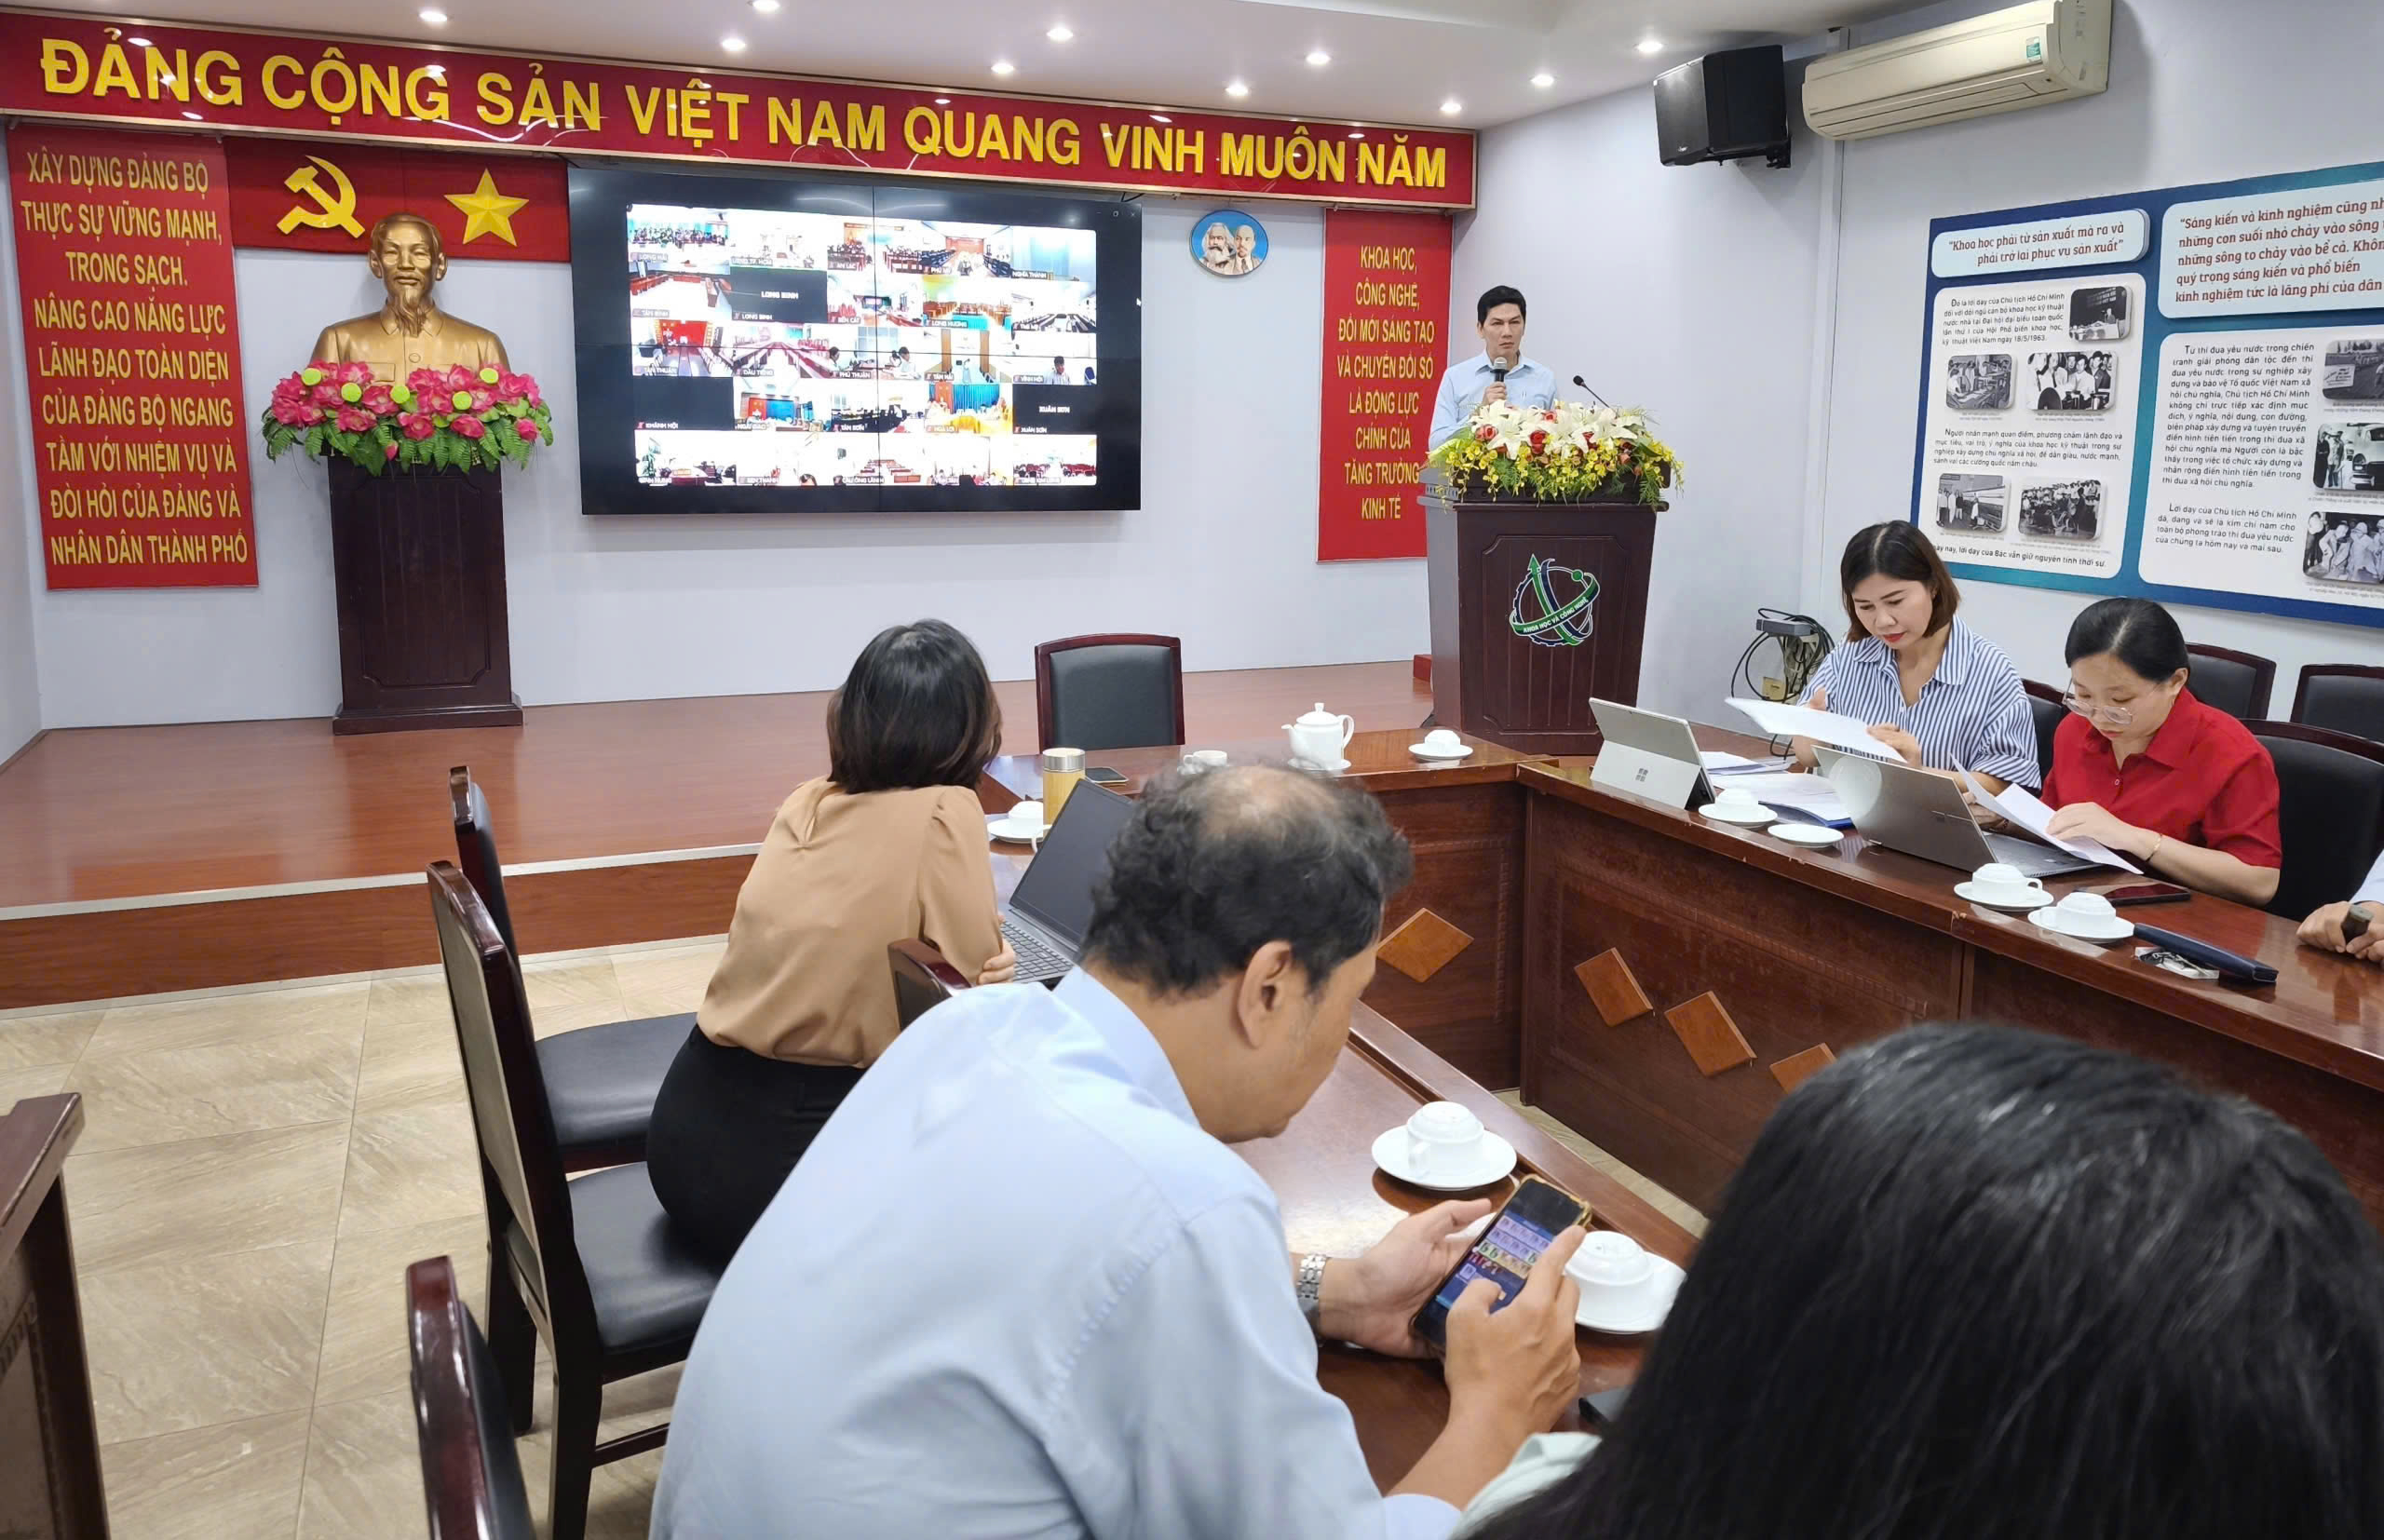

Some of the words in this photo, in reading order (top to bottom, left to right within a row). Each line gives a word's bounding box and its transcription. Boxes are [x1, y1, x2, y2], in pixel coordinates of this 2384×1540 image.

[40, 27, 243, 105] ĐẢNG
[262, 47, 450, 128] CỘNG
[477, 62, 601, 131] SẢN
[625, 78, 750, 148] VIỆT
[767, 97, 886, 152] NAM
[903, 106, 1079, 166] QUANG
[1100, 123, 1204, 173] VINH
[1220, 126, 1346, 182] MUÔN
[1359, 133, 1445, 188] NĂM
[27, 145, 63, 184] XÂY
[69, 155, 124, 194] DỰNG
[127, 152, 179, 192] ĐẢNG
[183, 159, 209, 200] BỘ
[20, 200, 74, 240] THỰC
[78, 203, 104, 242] SỰ
[108, 200, 162, 238] VỮNG
[166, 209, 222, 246] MẠNH,
[2215, 210, 2238, 226] kiến
[2241, 210, 2255, 223] và
[2257, 208, 2283, 222] kinh
[2287, 203, 2333, 221] nghiệm
[2336, 201, 2367, 214] cũng
[2179, 236, 2214, 248] những
[2216, 235, 2236, 244] con
[2239, 227, 2263, 243] suối
[2266, 226, 2288, 240] nhỏ
[2290, 223, 2321, 239] chảy
[2323, 222, 2346, 235] vào
[2349, 219, 2379, 234] sông
[65, 251, 129, 284] TRONG
[1361, 245, 1390, 269] KHOA
[1392, 247, 1417, 275] HỌC,
[2178, 253, 2213, 266] những
[2215, 250, 2242, 264] sông
[2244, 251, 2256, 261] to
[2258, 246, 2287, 261] chảy
[2290, 245, 2312, 257] vào
[2315, 239, 2330, 255] bể
[2332, 240, 2350, 253] cả.
[2176, 272, 2197, 287] quý
[2200, 272, 2229, 284] trọng
[2232, 268, 2260, 282] sáng
[2262, 263, 2287, 278] kiến
[2291, 263, 2305, 276] và
[2308, 259, 2332, 277] phổ
[2334, 257, 2361, 274] biến
[1356, 277, 1387, 306] CÔNG
[1388, 282, 1419, 312] NGHỆ,
[2175, 290, 2200, 303] kinh
[2201, 288, 2243, 304] nghiệm
[2246, 284, 2265, 298] tức
[2268, 285, 2278, 297] là
[2281, 284, 2308, 298] lãng
[2310, 282, 2329, 297] phí
[2332, 280, 2355, 293] của
[2358, 278, 2382, 291] dân
[34, 291, 87, 330] NÂNG
[91, 300, 129, 331] CAO
[134, 296, 185, 333] NĂNG
[189, 304, 226, 341] LỰC
[1338, 313, 1357, 342] ĐỔI
[1359, 314, 1379, 343] MỚI
[1382, 315, 1411, 343] SÁNG
[1414, 320, 1435, 348] TẠO
[38, 341, 88, 377] LÃNH
[91, 347, 131, 385] ĐẠO
[134, 343, 184, 379] TOÀN
[188, 348, 229, 387] DIỆN
[1337, 349, 1351, 378] VÀ
[1354, 350, 1397, 379] CHUYỂN
[1398, 351, 1416, 379] ĐỔI
[1418, 352, 1433, 380] SỐ
[42, 387, 82, 425] CỦA
[84, 388, 136, 426] ĐẢNG
[140, 394, 166, 433] BỘ
[170, 397, 234, 427] NGANG
[1348, 386, 1362, 413] LÀ
[1364, 389, 1395, 419] ĐỘNG
[1398, 391, 1419, 420] LỰC
[1356, 422, 1388, 450] CHÍNH
[1389, 422, 1411, 450] CỦA
[46, 435, 85, 471] TẦM
[88, 435, 121, 472] VỚI
[125, 440, 181, 480] NHIỆM
[183, 443, 208, 480] VỤ
[211, 437, 237, 472] VÀ
[1344, 458, 1373, 485] TĂNG
[1375, 457, 1419, 485] TRƯỞNG
[50, 482, 82, 519] ĐÒI
[86, 482, 117, 519] HỎI
[122, 482, 160, 519] CỦA
[162, 482, 212, 518] ĐẢNG
[216, 483, 241, 518] VÀ
[1361, 497, 1386, 520] KINH
[1388, 493, 1401, 519] TẾ
[50, 529, 102, 565] NHÂN
[105, 528, 143, 563] DÂN
[146, 528, 208, 564] THÀNH
[211, 528, 248, 563] PHỐ
